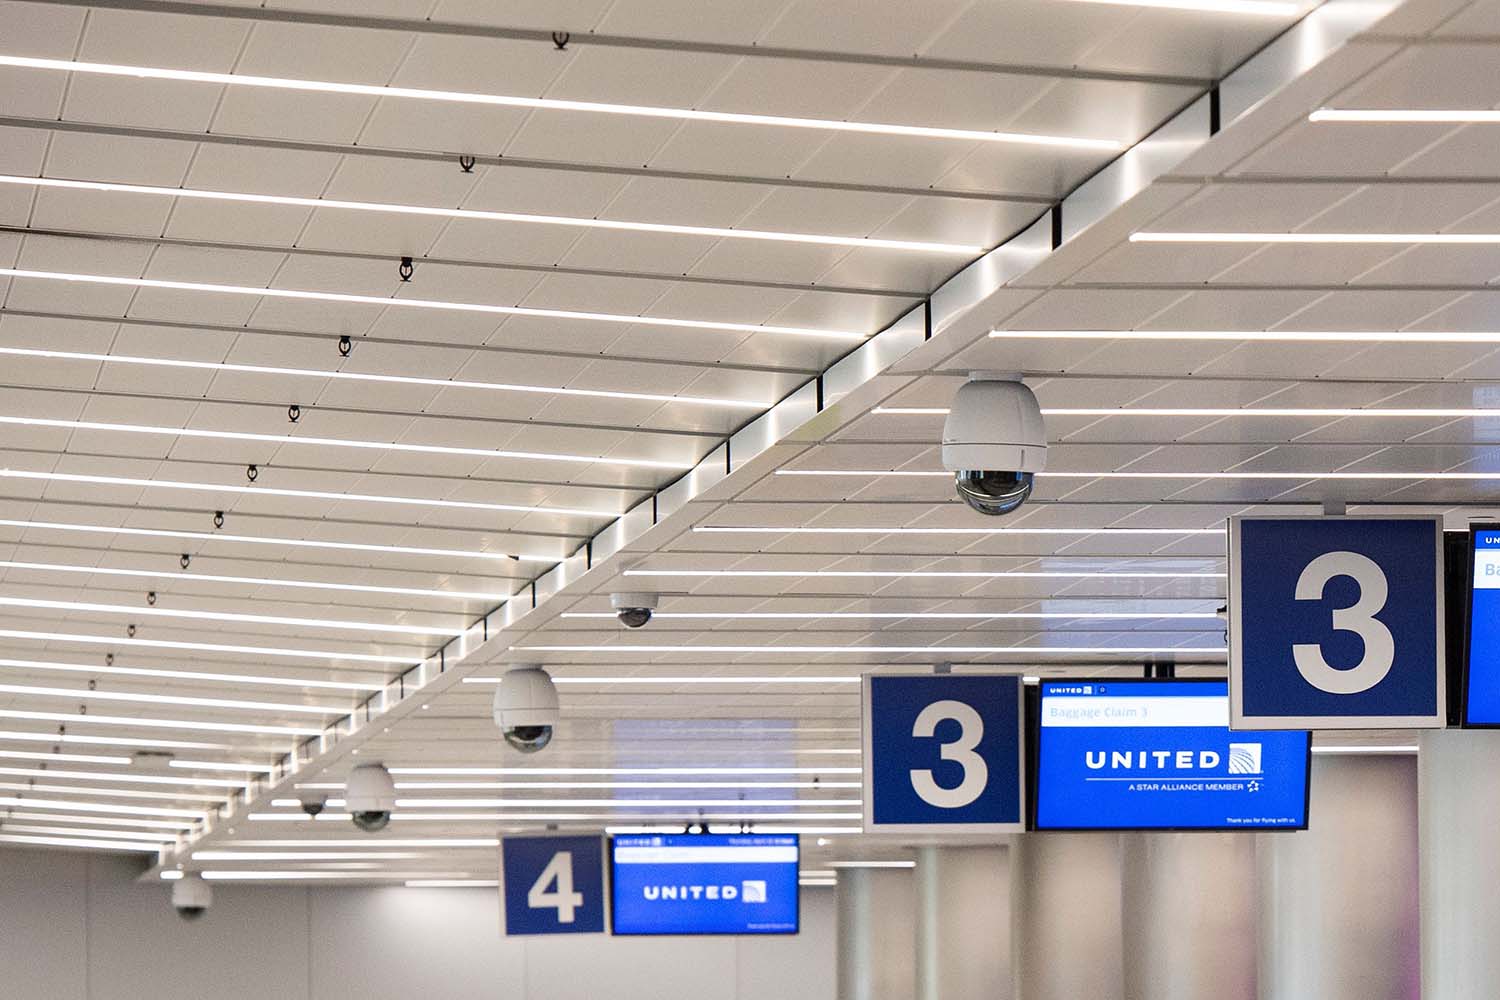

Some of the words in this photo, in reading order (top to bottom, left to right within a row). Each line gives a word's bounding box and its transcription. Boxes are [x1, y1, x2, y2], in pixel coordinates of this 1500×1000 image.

[1293, 551, 1395, 694] 3
[910, 700, 988, 808] 3
[1085, 751, 1221, 769] UNITED
[1161, 783, 1204, 791] ALLIANCE
[1205, 783, 1244, 791] MEMBER
[528, 852, 583, 923] 4
[644, 885, 738, 901] UNITED
